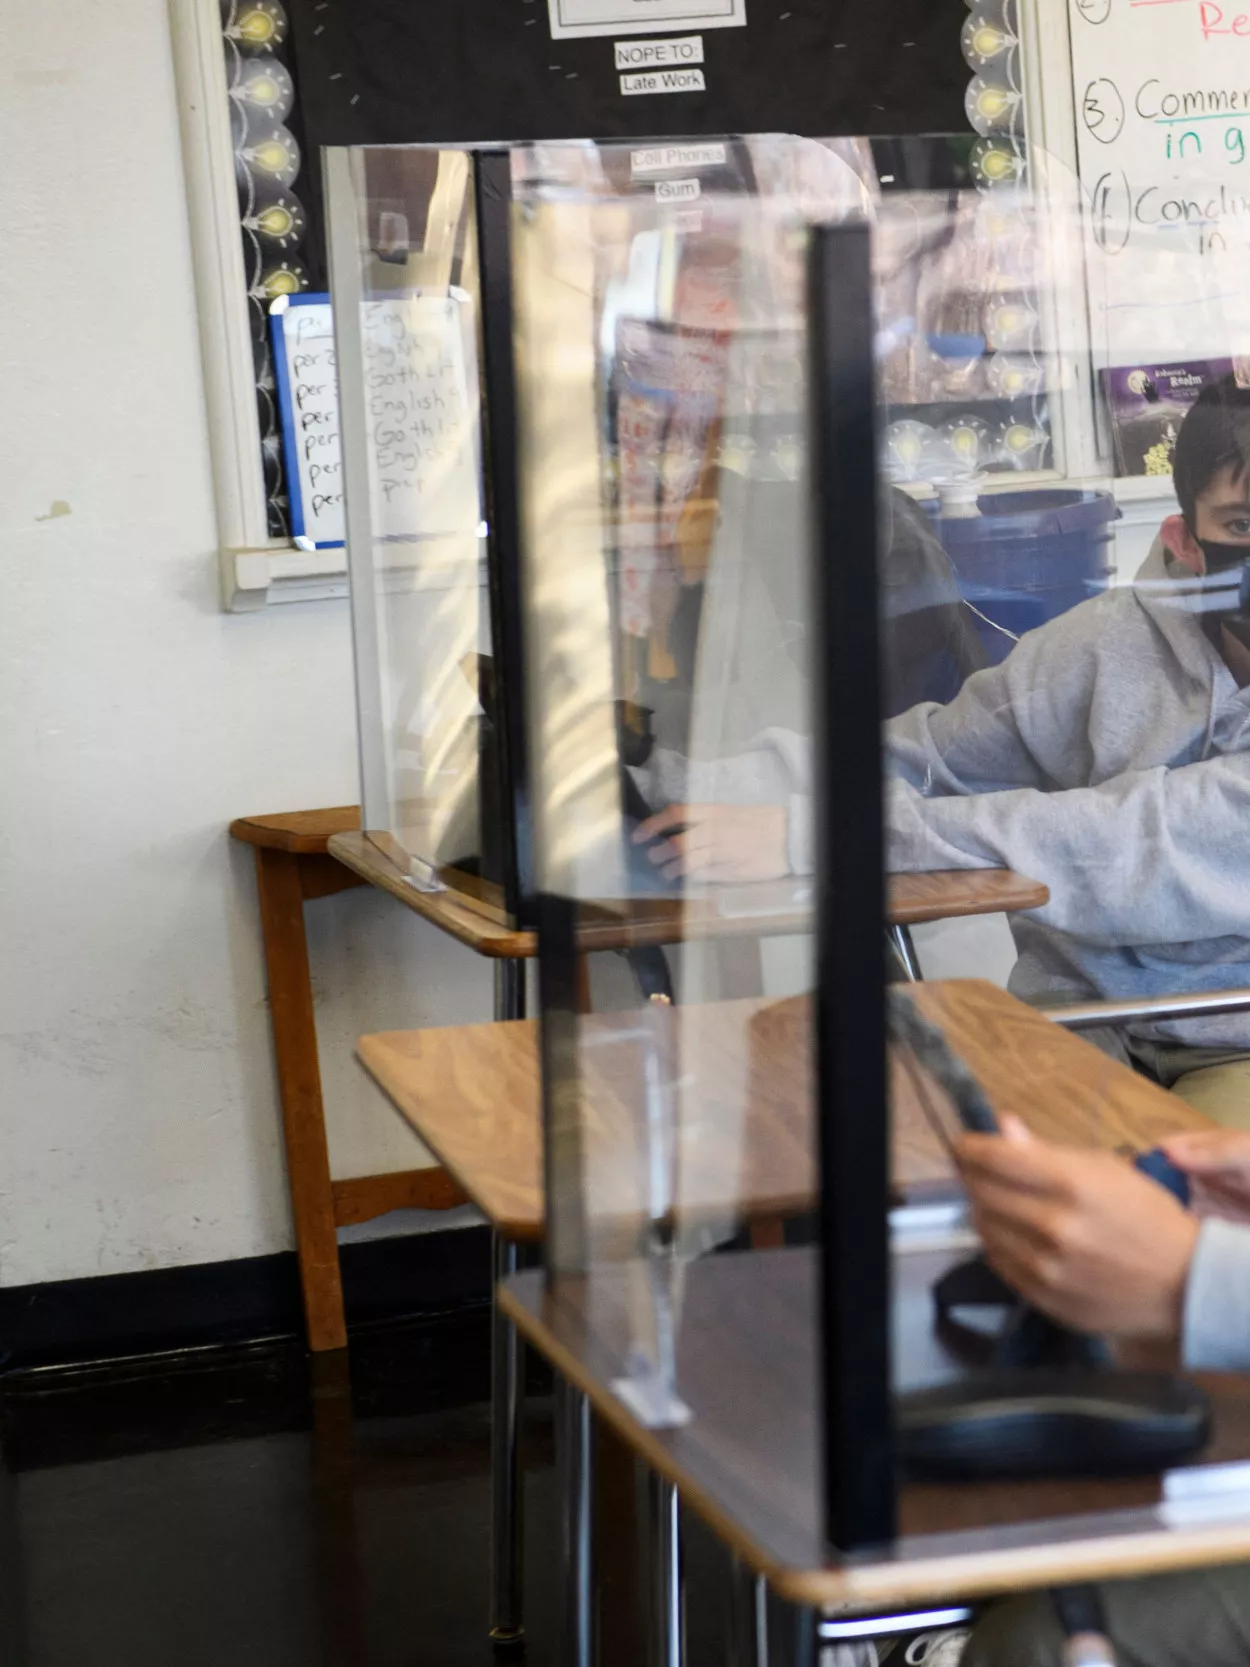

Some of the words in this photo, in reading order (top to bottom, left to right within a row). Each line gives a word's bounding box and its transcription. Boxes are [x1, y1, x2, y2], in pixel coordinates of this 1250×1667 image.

[617, 46, 666, 63] NOPE
[623, 75, 657, 90] Late
[660, 70, 701, 88] Work
[1165, 122, 1201, 158] in
[633, 150, 662, 166] Cell
[658, 182, 695, 198] Gum
[297, 384, 327, 410] per
[302, 411, 334, 432] per
[305, 433, 339, 461] per
[309, 462, 342, 489] per
